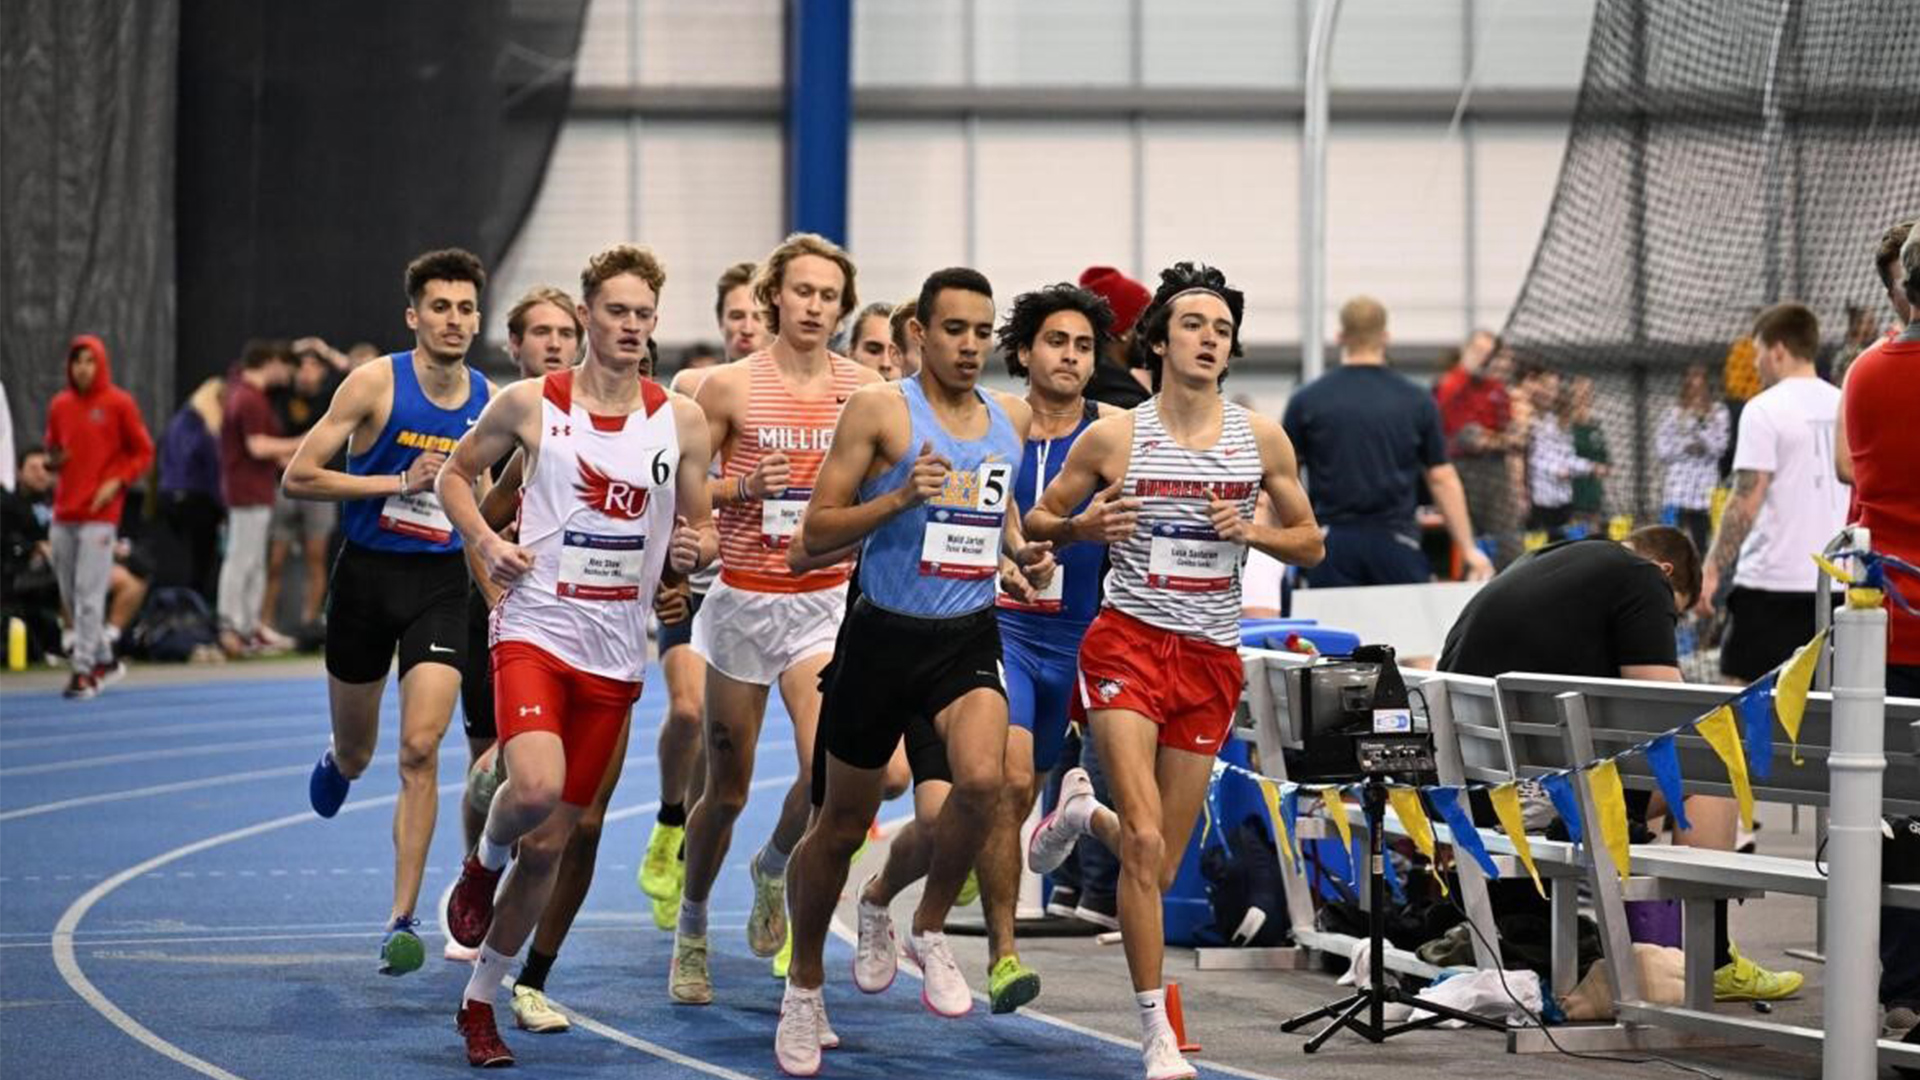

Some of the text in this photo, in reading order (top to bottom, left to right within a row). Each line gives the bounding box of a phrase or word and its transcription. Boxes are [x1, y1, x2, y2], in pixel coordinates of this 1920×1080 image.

[651, 448, 670, 486] 6
[604, 482, 650, 518] RU
[983, 469, 1006, 506] 5
